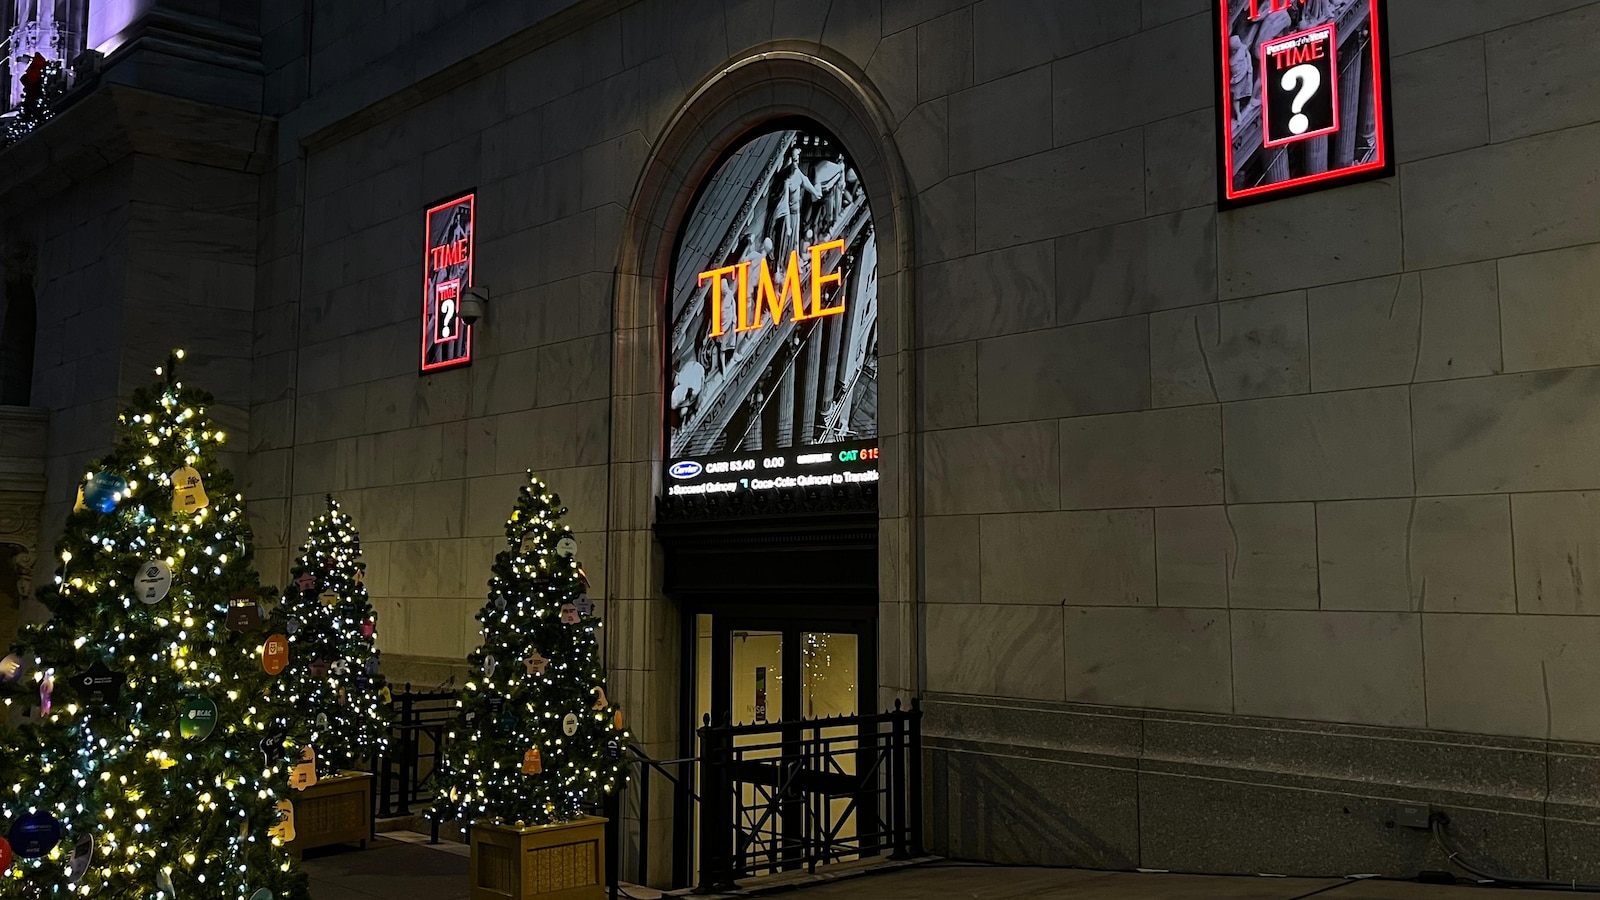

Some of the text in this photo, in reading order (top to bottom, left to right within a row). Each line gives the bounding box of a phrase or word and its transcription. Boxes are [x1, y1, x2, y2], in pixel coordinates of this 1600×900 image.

[1272, 39, 1324, 70] TIME
[1281, 64, 1320, 135] ?
[431, 238, 467, 271] TIME
[440, 287, 456, 301] TIME
[698, 238, 845, 337] TIME
[839, 450, 858, 461] CAT
[673, 465, 699, 475] Carrier
[705, 462, 729, 473] CARR
[730, 459, 755, 471] 53.40
[763, 457, 784, 469] 0.00
[832, 473, 843, 484] to
